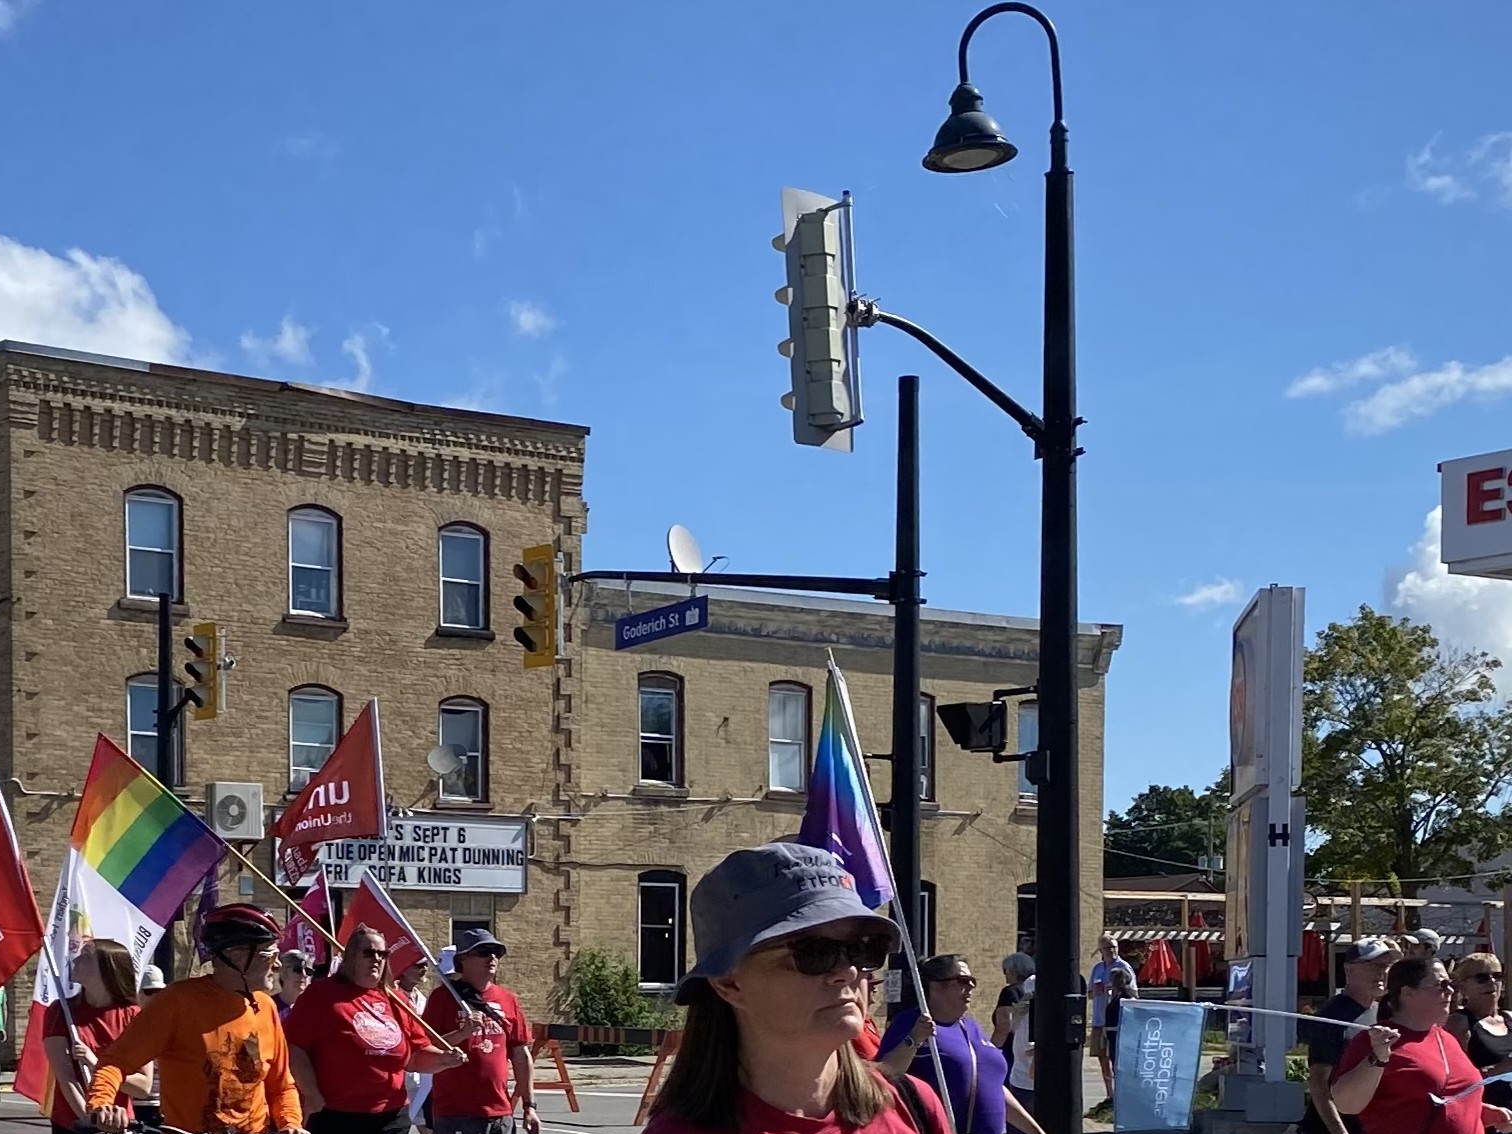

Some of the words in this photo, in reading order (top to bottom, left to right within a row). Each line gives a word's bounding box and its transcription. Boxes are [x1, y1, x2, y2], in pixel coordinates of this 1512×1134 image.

[1466, 467, 1512, 526] E
[622, 615, 667, 641] Goderich
[668, 612, 680, 628] St
[413, 825, 449, 844] SEPT
[458, 827, 467, 844] 6
[325, 843, 354, 861] TUE
[358, 844, 396, 862] OPEN
[399, 845, 425, 864] MIC
[429, 847, 459, 865] PAT
[462, 848, 524, 866] DUNNING
[326, 863, 349, 881] FRI
[368, 865, 407, 883] SOFA
[417, 866, 462, 884] KINGS
